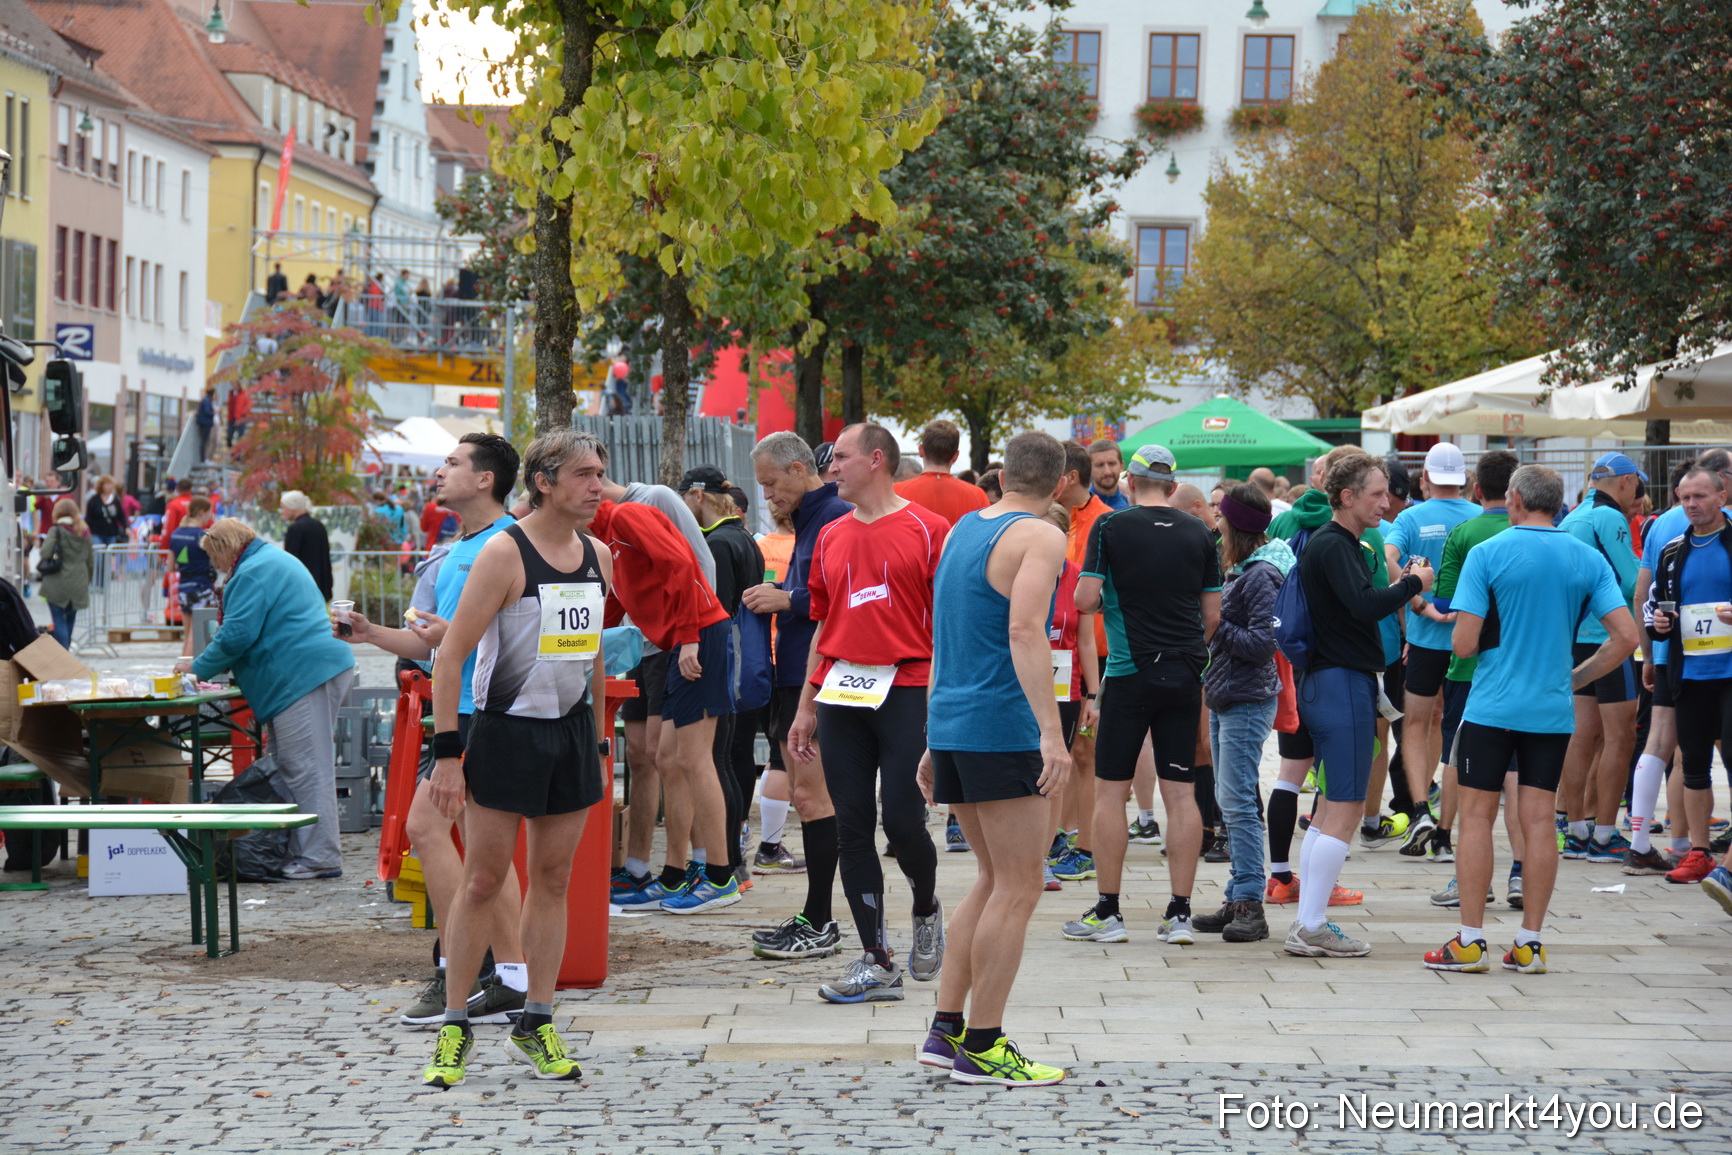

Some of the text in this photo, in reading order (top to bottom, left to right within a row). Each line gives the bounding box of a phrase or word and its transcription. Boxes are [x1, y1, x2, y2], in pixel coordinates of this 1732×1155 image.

[1169, 438, 1257, 446] Lammsbräu
[859, 590, 877, 600] DEHN
[558, 607, 590, 630] 103
[1695, 619, 1713, 635] 47
[557, 638, 588, 648] Sebastian
[838, 692, 865, 700] Rüdiger
[107, 843, 167, 860] ja! DOPPELKEKS
